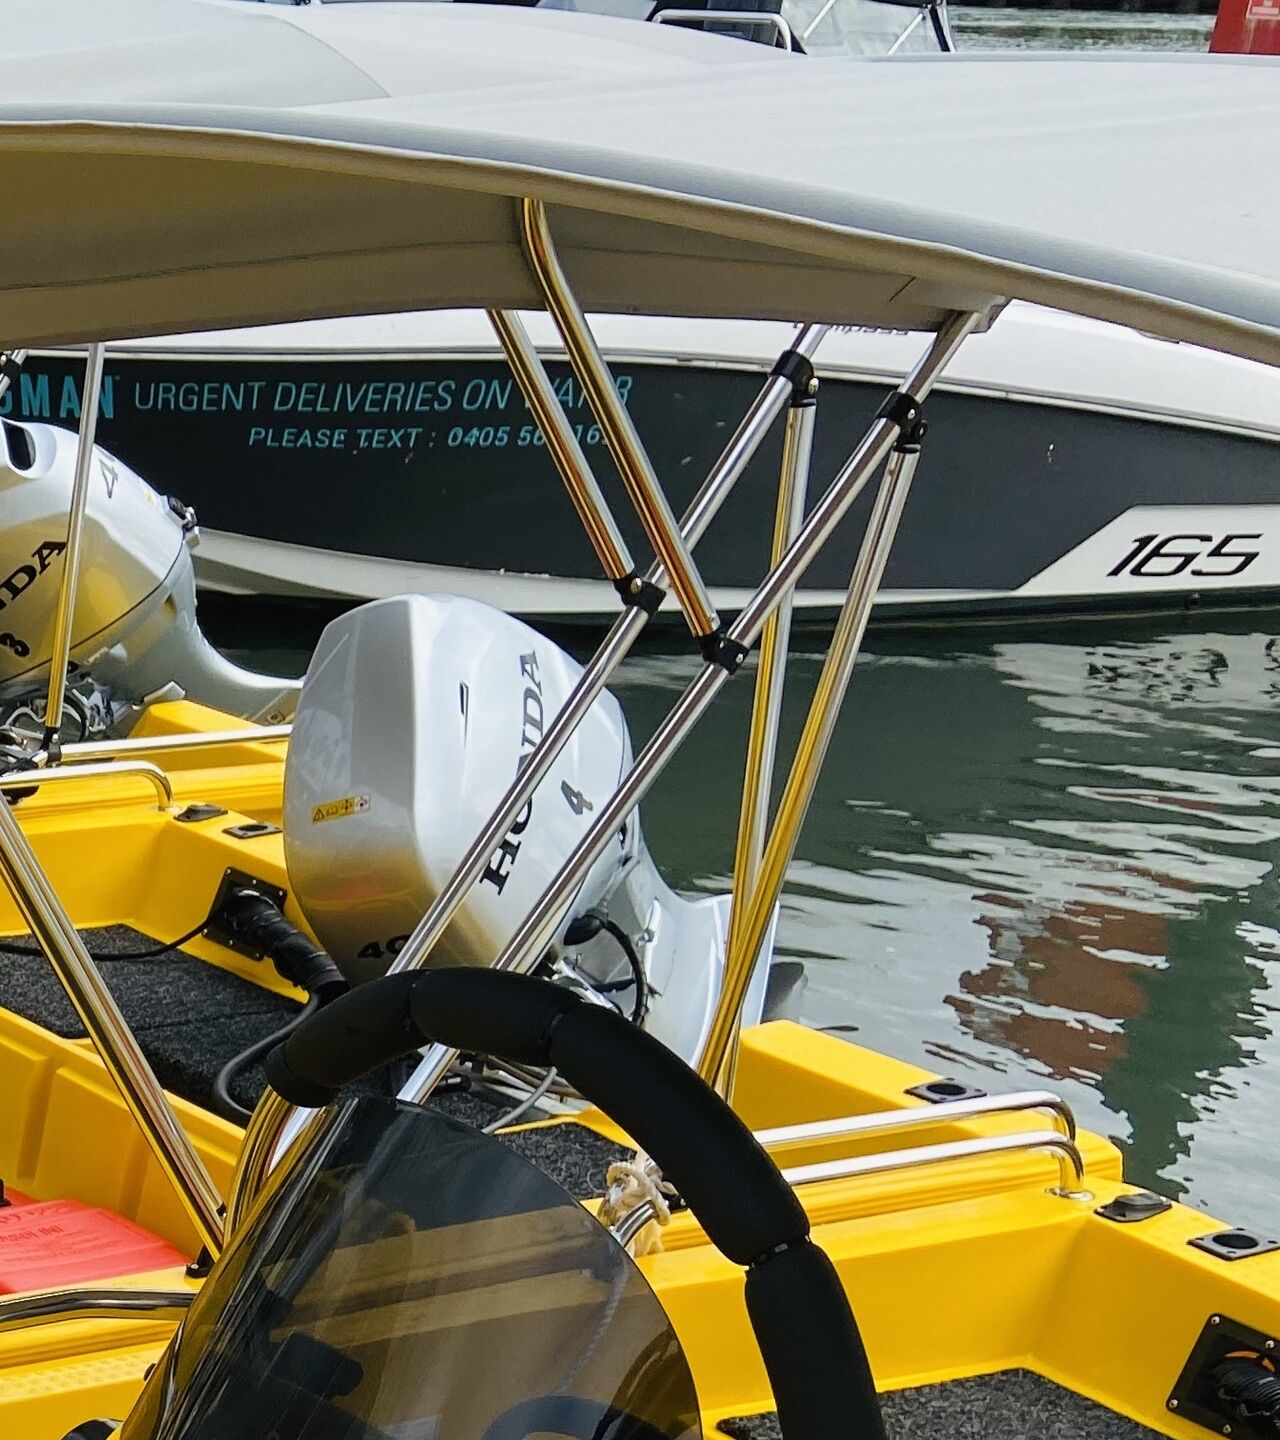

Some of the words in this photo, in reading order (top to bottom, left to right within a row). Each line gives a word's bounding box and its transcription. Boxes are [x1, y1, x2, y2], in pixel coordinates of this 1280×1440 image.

[134, 382, 267, 412] URGENT
[273, 378, 456, 413] DELIVERIES
[462, 377, 513, 410] ON
[248, 427, 348, 448] PLEASE
[357, 427, 423, 447] TEXT
[447, 425, 511, 447] 0405
[1105, 533, 1264, 577] 165
[560, 779, 594, 816] 4
